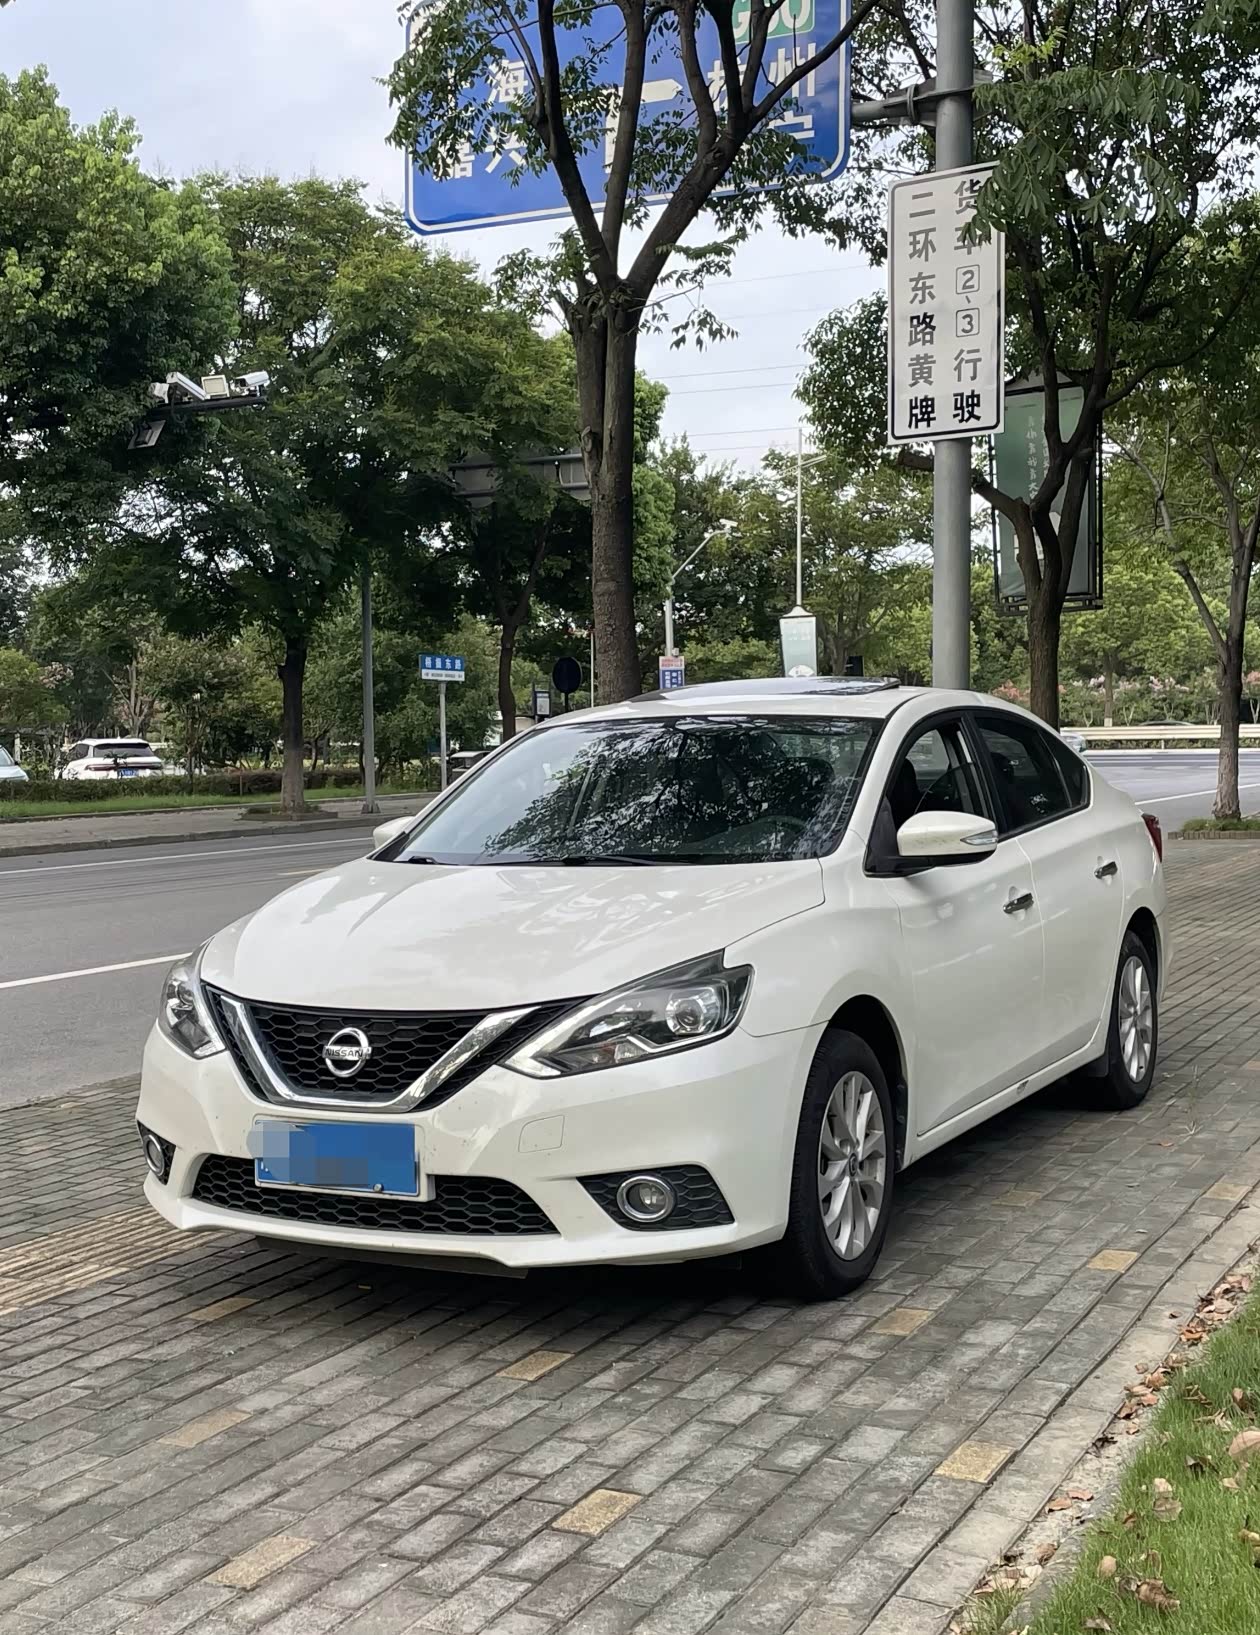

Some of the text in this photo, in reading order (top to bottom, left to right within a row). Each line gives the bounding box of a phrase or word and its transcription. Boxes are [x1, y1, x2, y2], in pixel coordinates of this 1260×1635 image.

[908, 191, 937, 429] 二环东路黄牌
[324, 1048, 364, 1058] NISSAN
